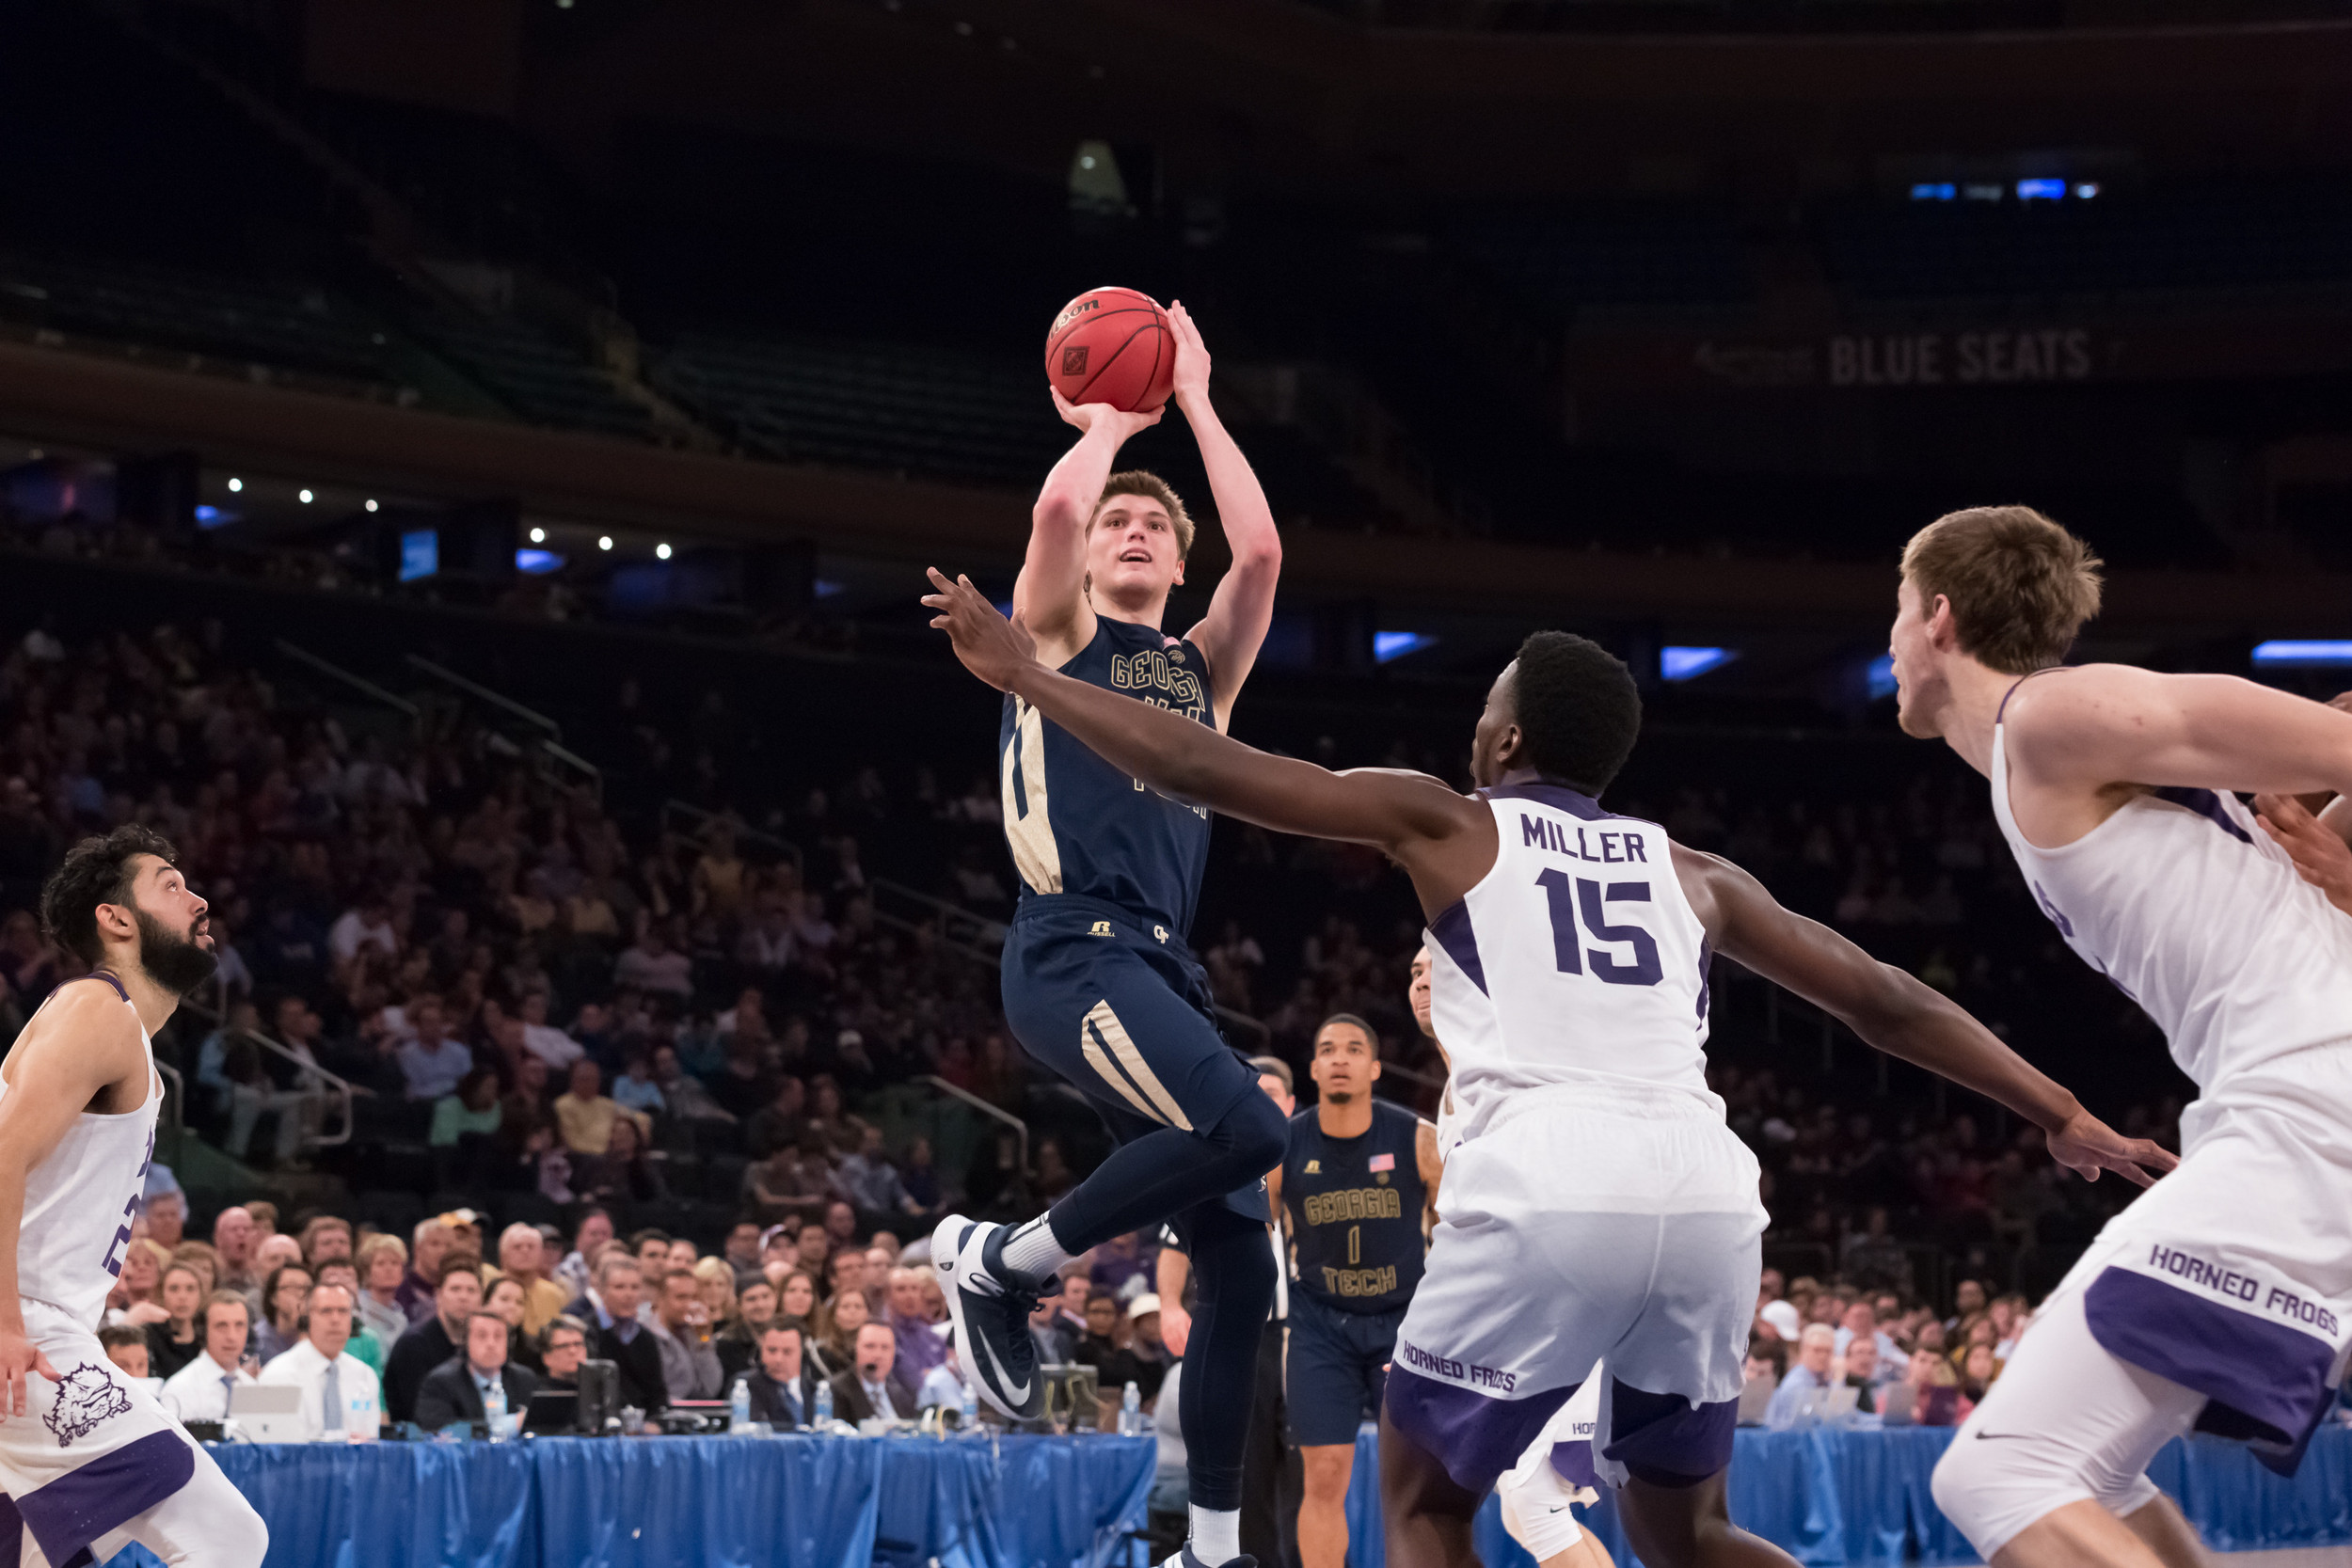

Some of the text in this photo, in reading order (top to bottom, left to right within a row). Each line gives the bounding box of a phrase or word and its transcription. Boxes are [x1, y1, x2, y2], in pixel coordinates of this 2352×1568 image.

[1828, 333, 1943, 386] BLUE
[1957, 329, 2090, 381] SEATS
[1520, 813, 1648, 863] MILLER
[1534, 867, 1663, 987] 15
[1304, 1187, 1401, 1227] GEORGIA
[1347, 1225, 1360, 1265] 1
[1321, 1264, 1397, 1297] TECH
[2149, 1243, 2338, 1337] HORNED FROGS
[1403, 1339, 1465, 1379] HORNED
